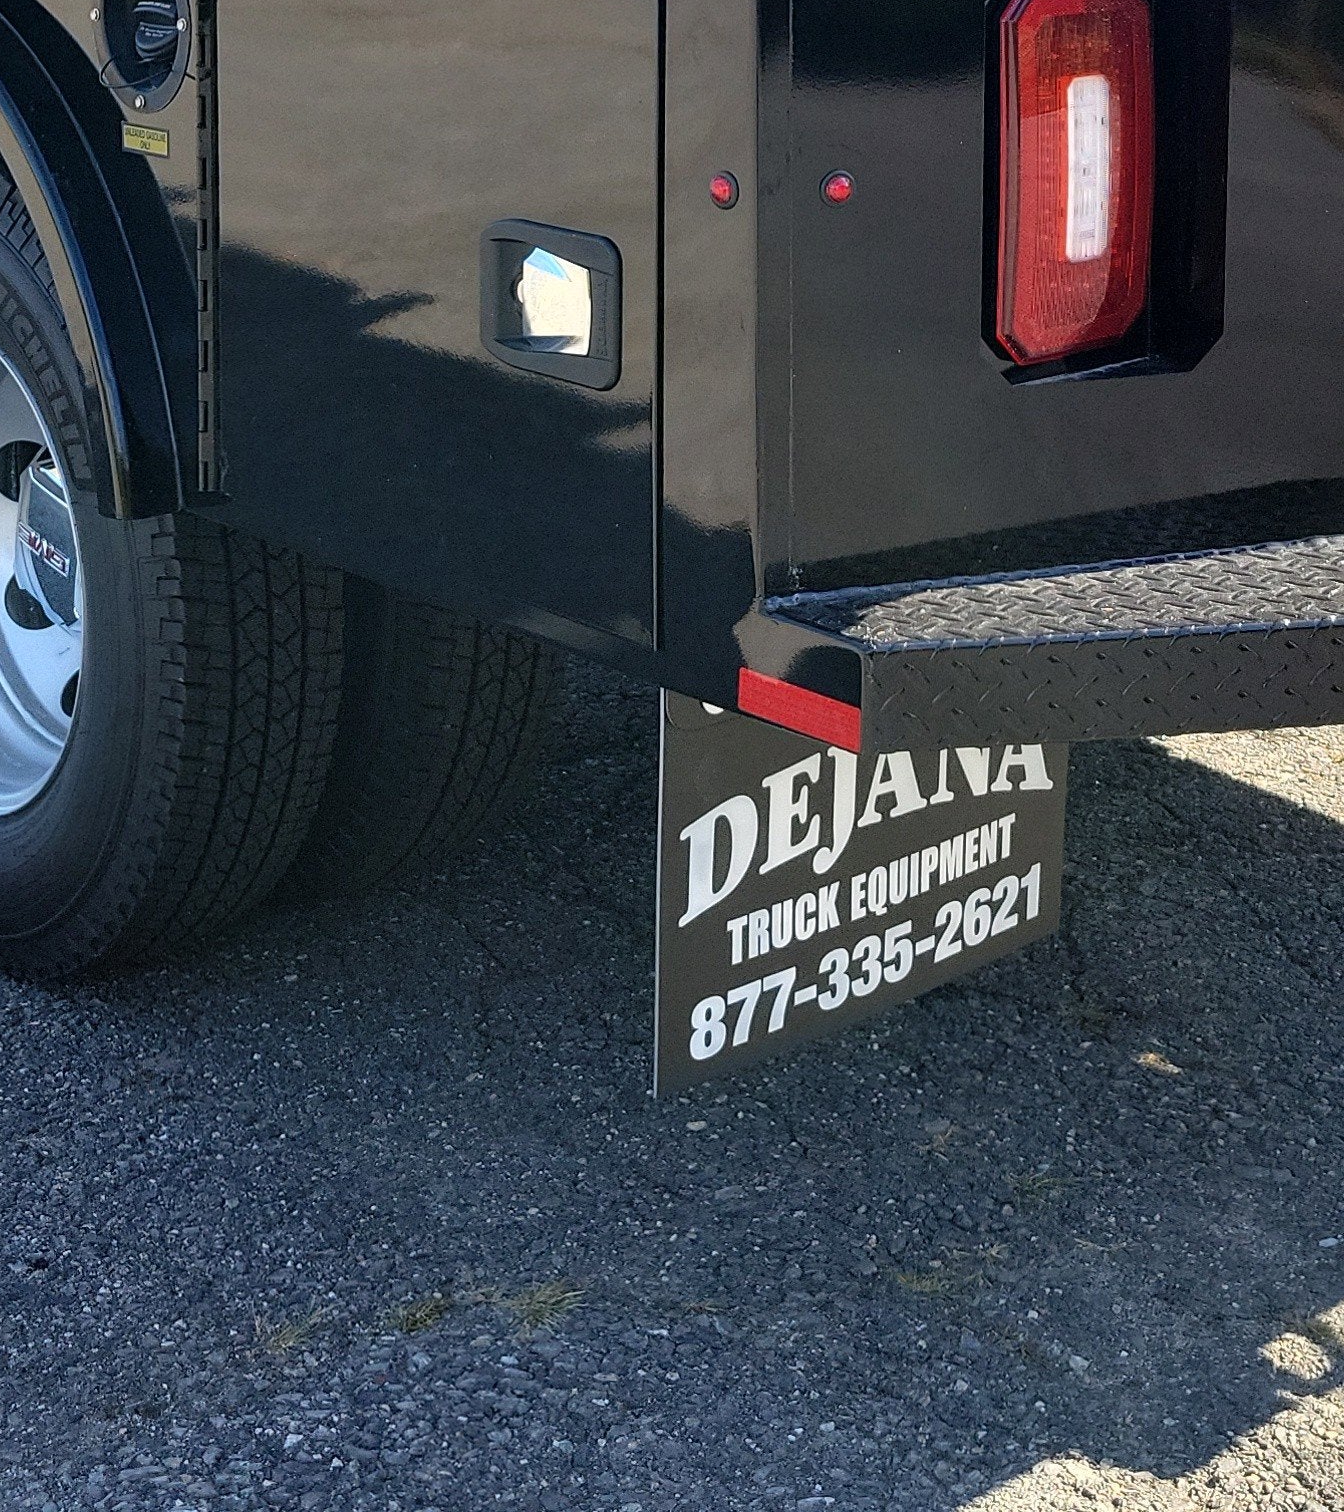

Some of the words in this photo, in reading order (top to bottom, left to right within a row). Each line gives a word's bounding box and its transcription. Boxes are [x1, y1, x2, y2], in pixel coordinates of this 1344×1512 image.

[17, 521, 71, 578] GMC
[678, 743, 1053, 928] DEJANA
[727, 881, 840, 966] TRUCK
[851, 813, 1016, 921] EQUIPMENT
[688, 862, 1041, 1061] 877-335-2621
